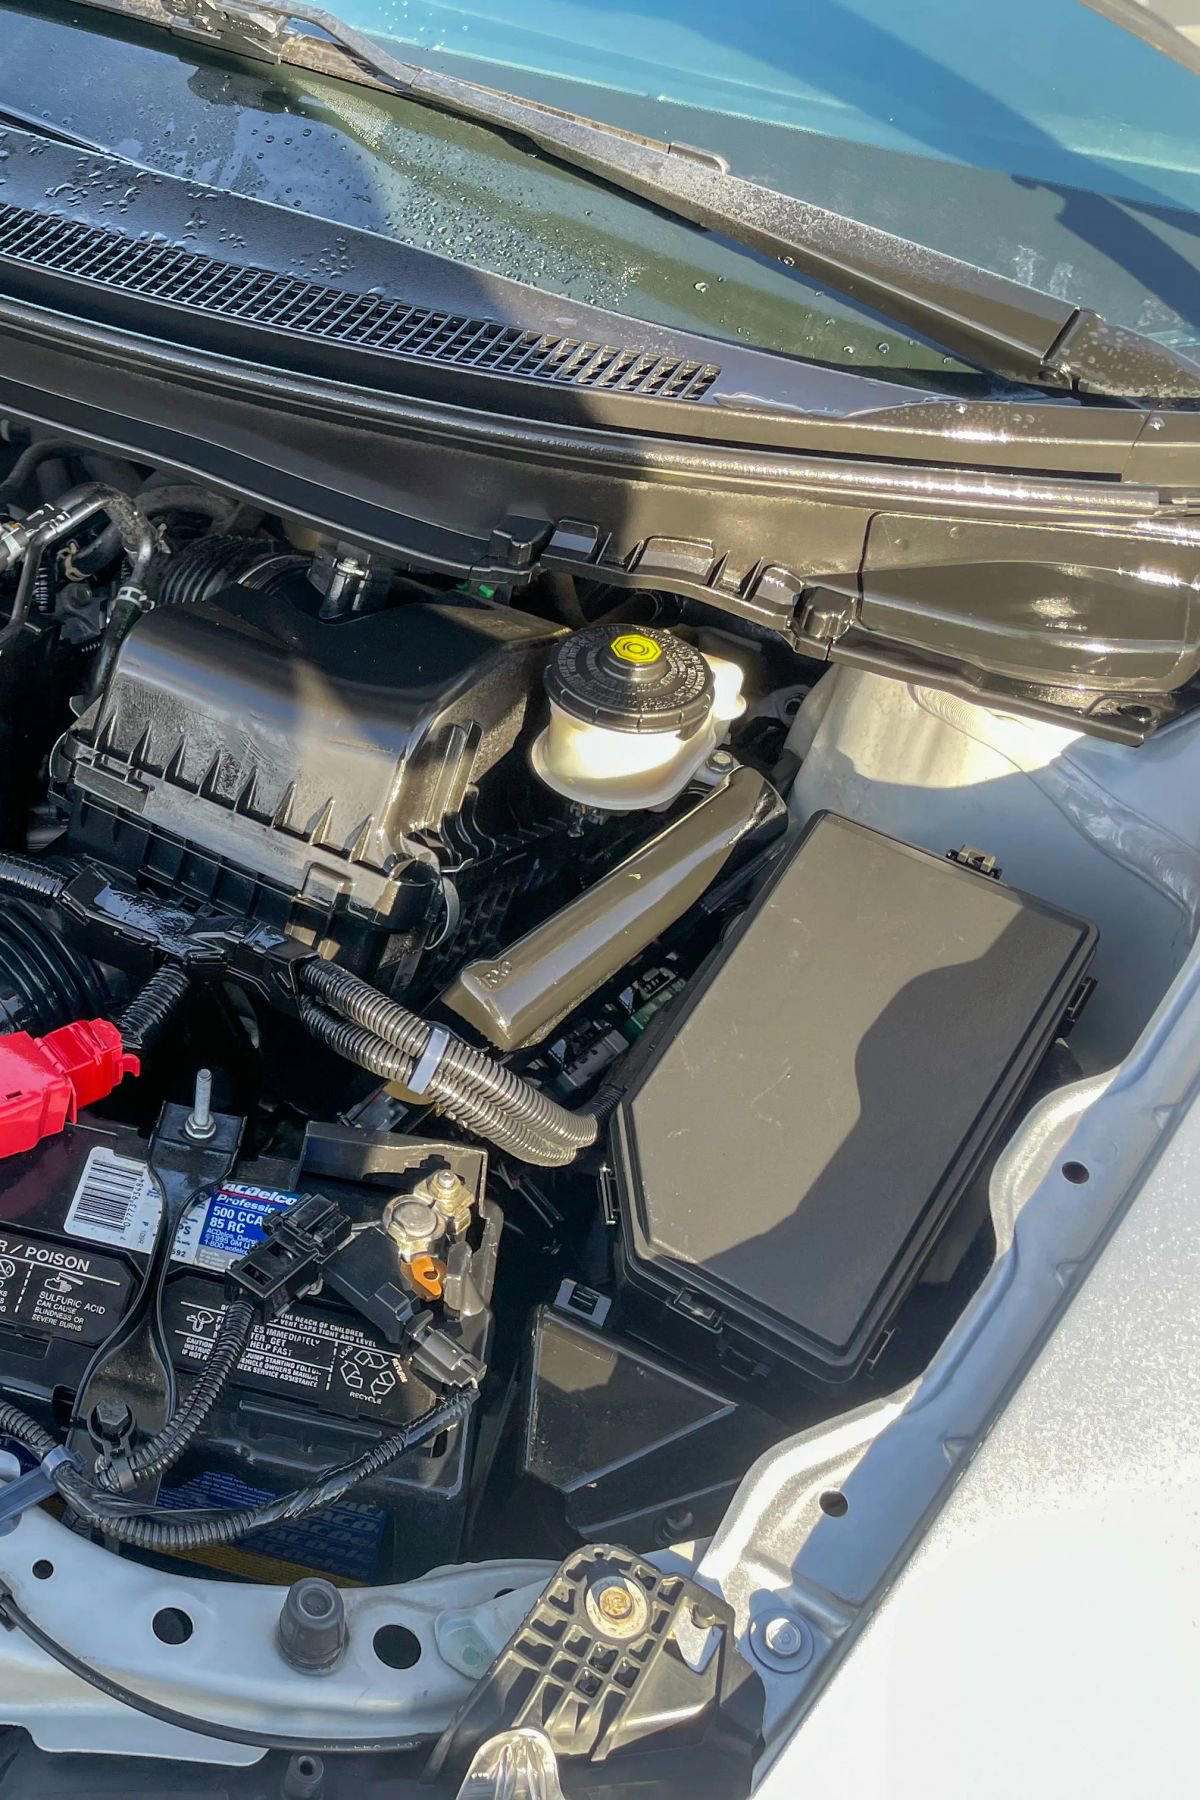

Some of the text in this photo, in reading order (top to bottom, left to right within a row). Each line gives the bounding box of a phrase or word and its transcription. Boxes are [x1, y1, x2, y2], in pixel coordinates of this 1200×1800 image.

[222, 1183, 298, 1206] ACDelco
[209, 1216, 246, 1234] 85 RC
[213, 1205, 263, 1227] 500 CCA
[25, 1246, 90, 1272] POISON
[36, 1299, 77, 1315] CAN CAUSE
[39, 1290, 106, 1315] SULFURIC ACID
[31, 1313, 83, 1332] SEVERE BURNS
[34, 1306, 85, 1325] BLINDNESS OR
[280, 1319, 297, 1328] VENT
[299, 1323, 317, 1332] CAPS
[355, 1336, 377, 1348] LEVEL
[295, 1315, 318, 1326] REACH
[329, 1324, 364, 1338] CHILDREN
[184, 1343, 211, 1355] INSTRUC
[250, 1340, 293, 1357] HELP FAST
[270, 1337, 286, 1347] GET
[339, 1345, 354, 1359] LEAD
[349, 1391, 383, 1405] RECYCLE
